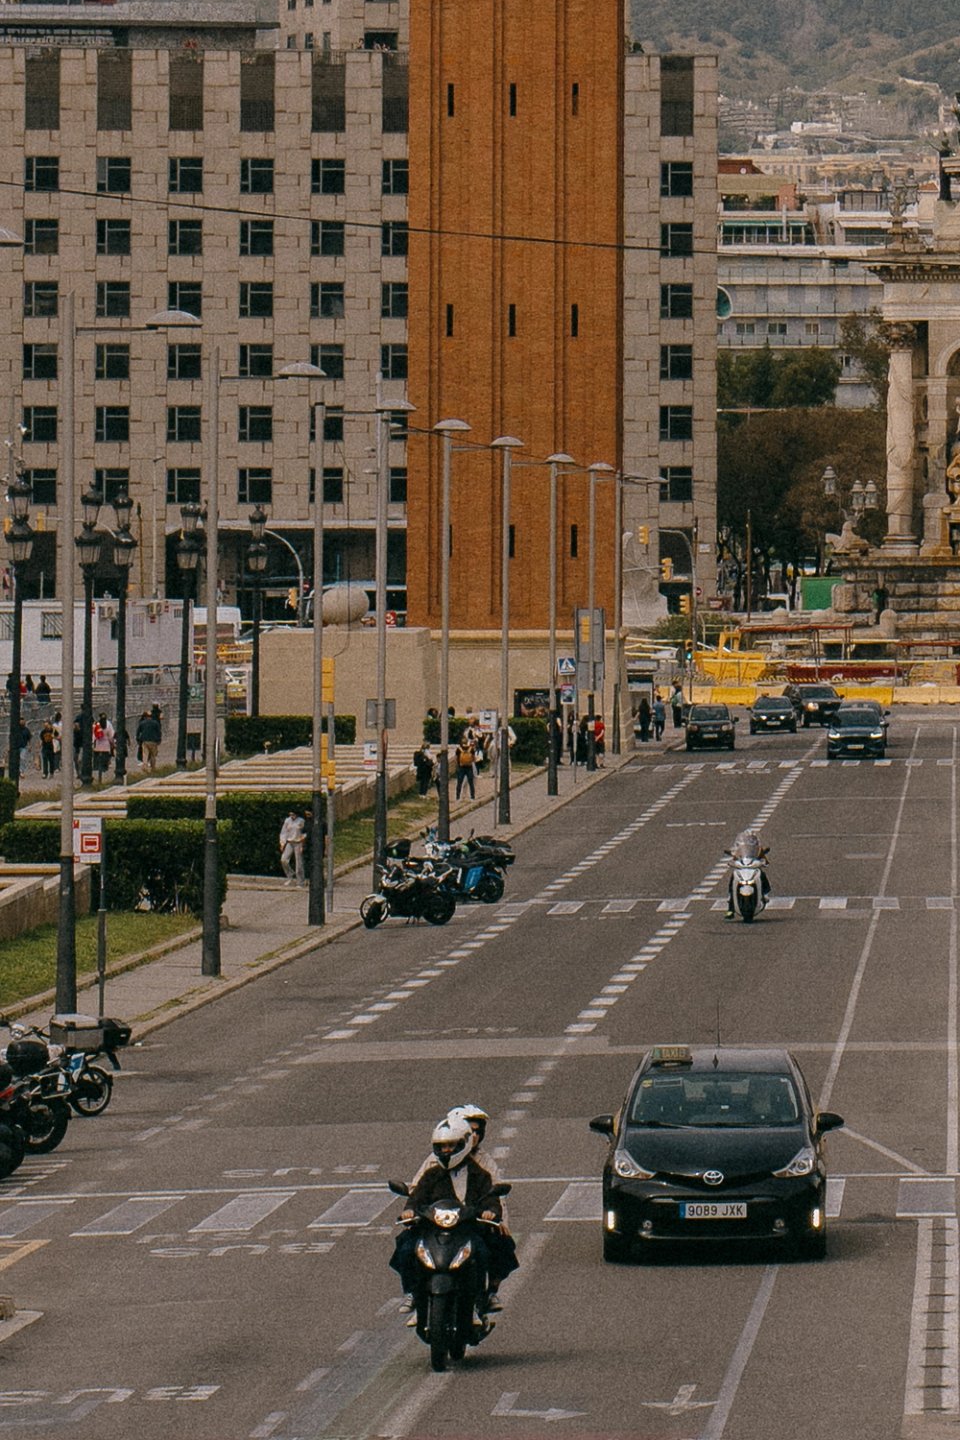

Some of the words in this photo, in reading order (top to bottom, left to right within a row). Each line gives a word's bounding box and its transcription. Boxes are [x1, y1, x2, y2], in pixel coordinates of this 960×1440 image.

[688, 1205, 717, 1216] 9089
[722, 1205, 743, 1216] JXK
[149, 1241, 335, 1258] BUS
